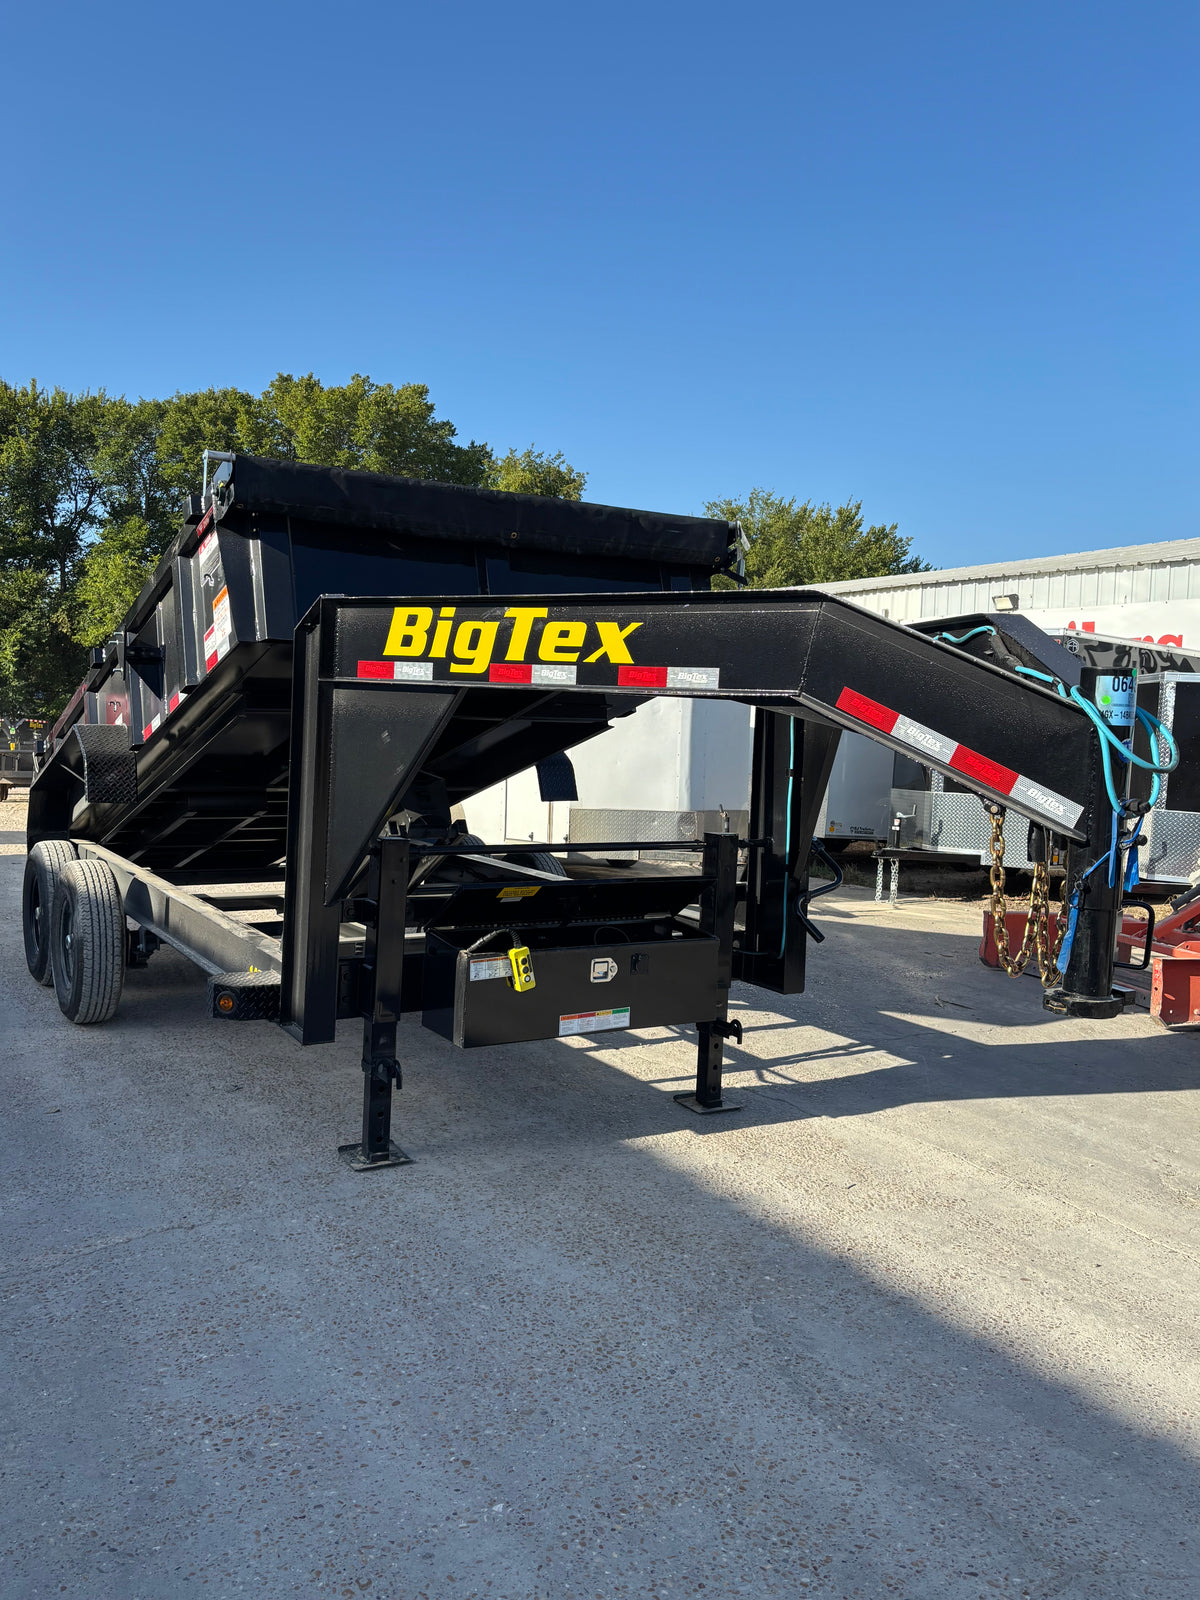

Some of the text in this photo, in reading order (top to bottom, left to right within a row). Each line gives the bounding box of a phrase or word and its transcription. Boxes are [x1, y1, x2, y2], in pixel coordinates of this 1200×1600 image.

[383, 606, 643, 674] BigTex
[541, 669, 568, 680] BigTex
[677, 672, 708, 683] BigTex
[907, 725, 943, 752] BigTex
[1027, 787, 1067, 816] BigTex
